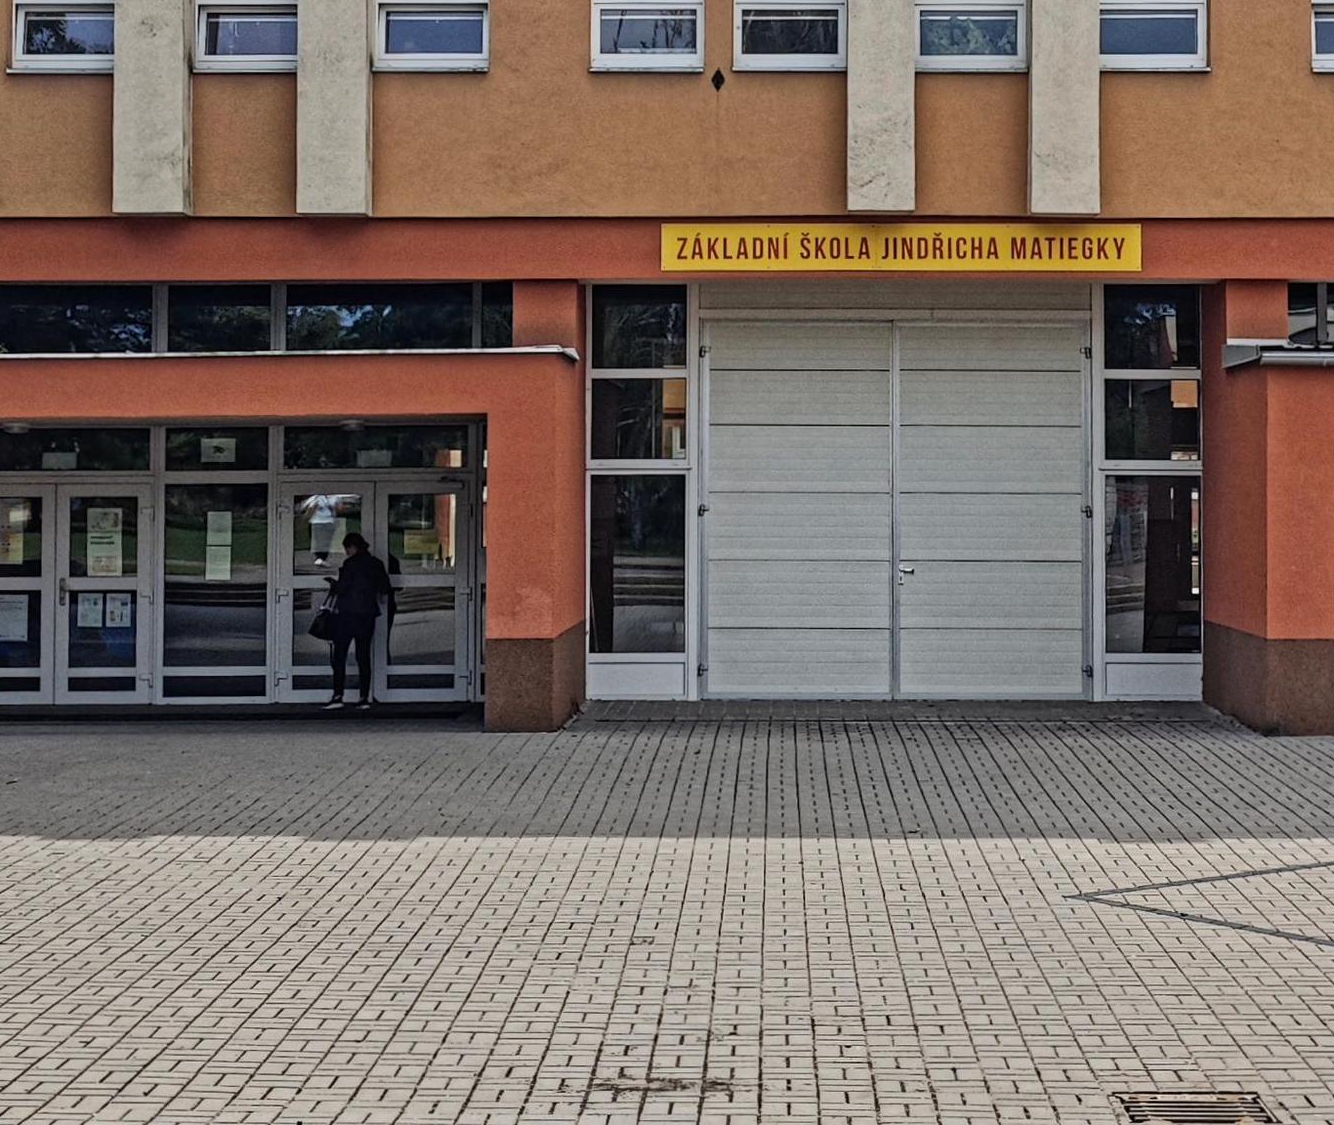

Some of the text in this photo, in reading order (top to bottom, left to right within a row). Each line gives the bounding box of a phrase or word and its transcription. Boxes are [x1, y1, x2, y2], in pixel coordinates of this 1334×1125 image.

[676, 232, 1126, 260] ZÁKLADNÍ ŠKOLA JINDŘICHA MATIEGKY
